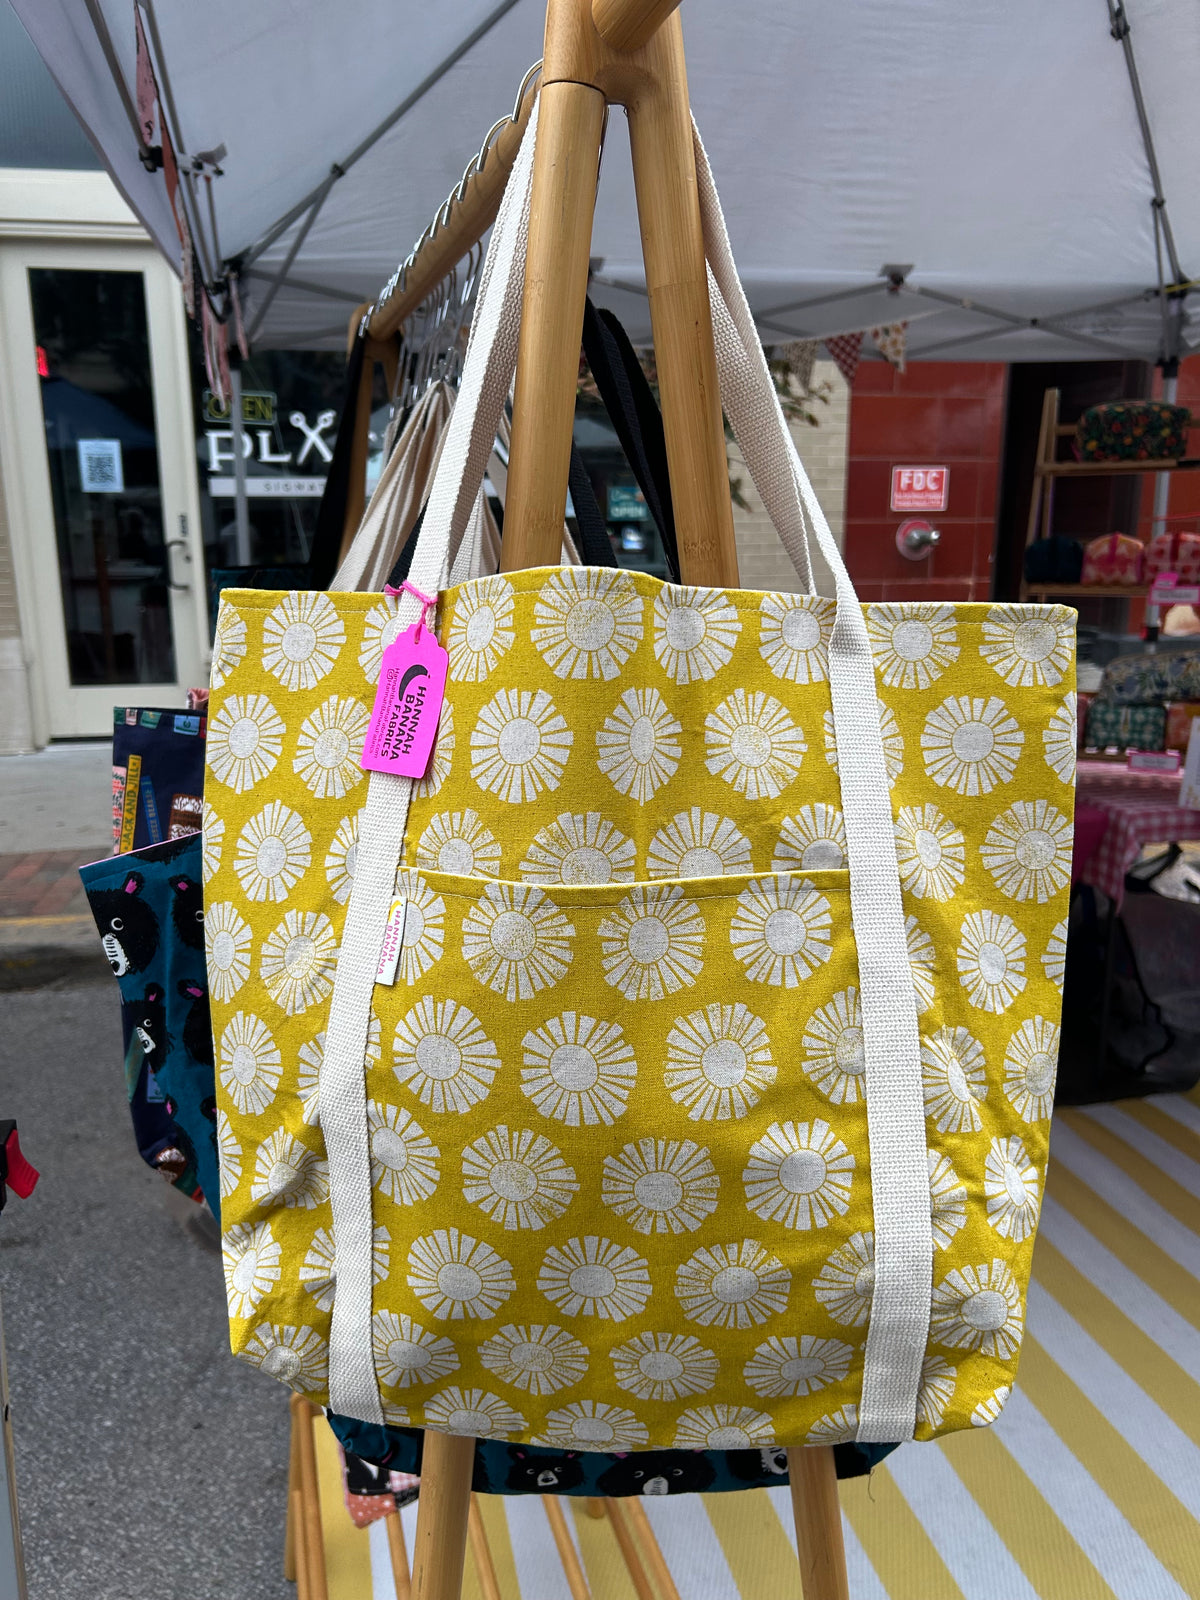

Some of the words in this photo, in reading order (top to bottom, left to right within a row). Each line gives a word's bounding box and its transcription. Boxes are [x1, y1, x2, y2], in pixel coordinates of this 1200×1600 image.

[208, 396, 273, 420] OEN
[900, 471, 940, 490] FDC
[381, 704, 401, 757] FABRICS
[389, 694, 415, 760] BANANA
[402, 685, 427, 754] HANNAH
[129, 766, 140, 789] JILL
[126, 790, 136, 813] AND
[123, 818, 133, 846] JACK
[377, 925, 394, 975] BANANA
[387, 910, 402, 962] HANNAH
